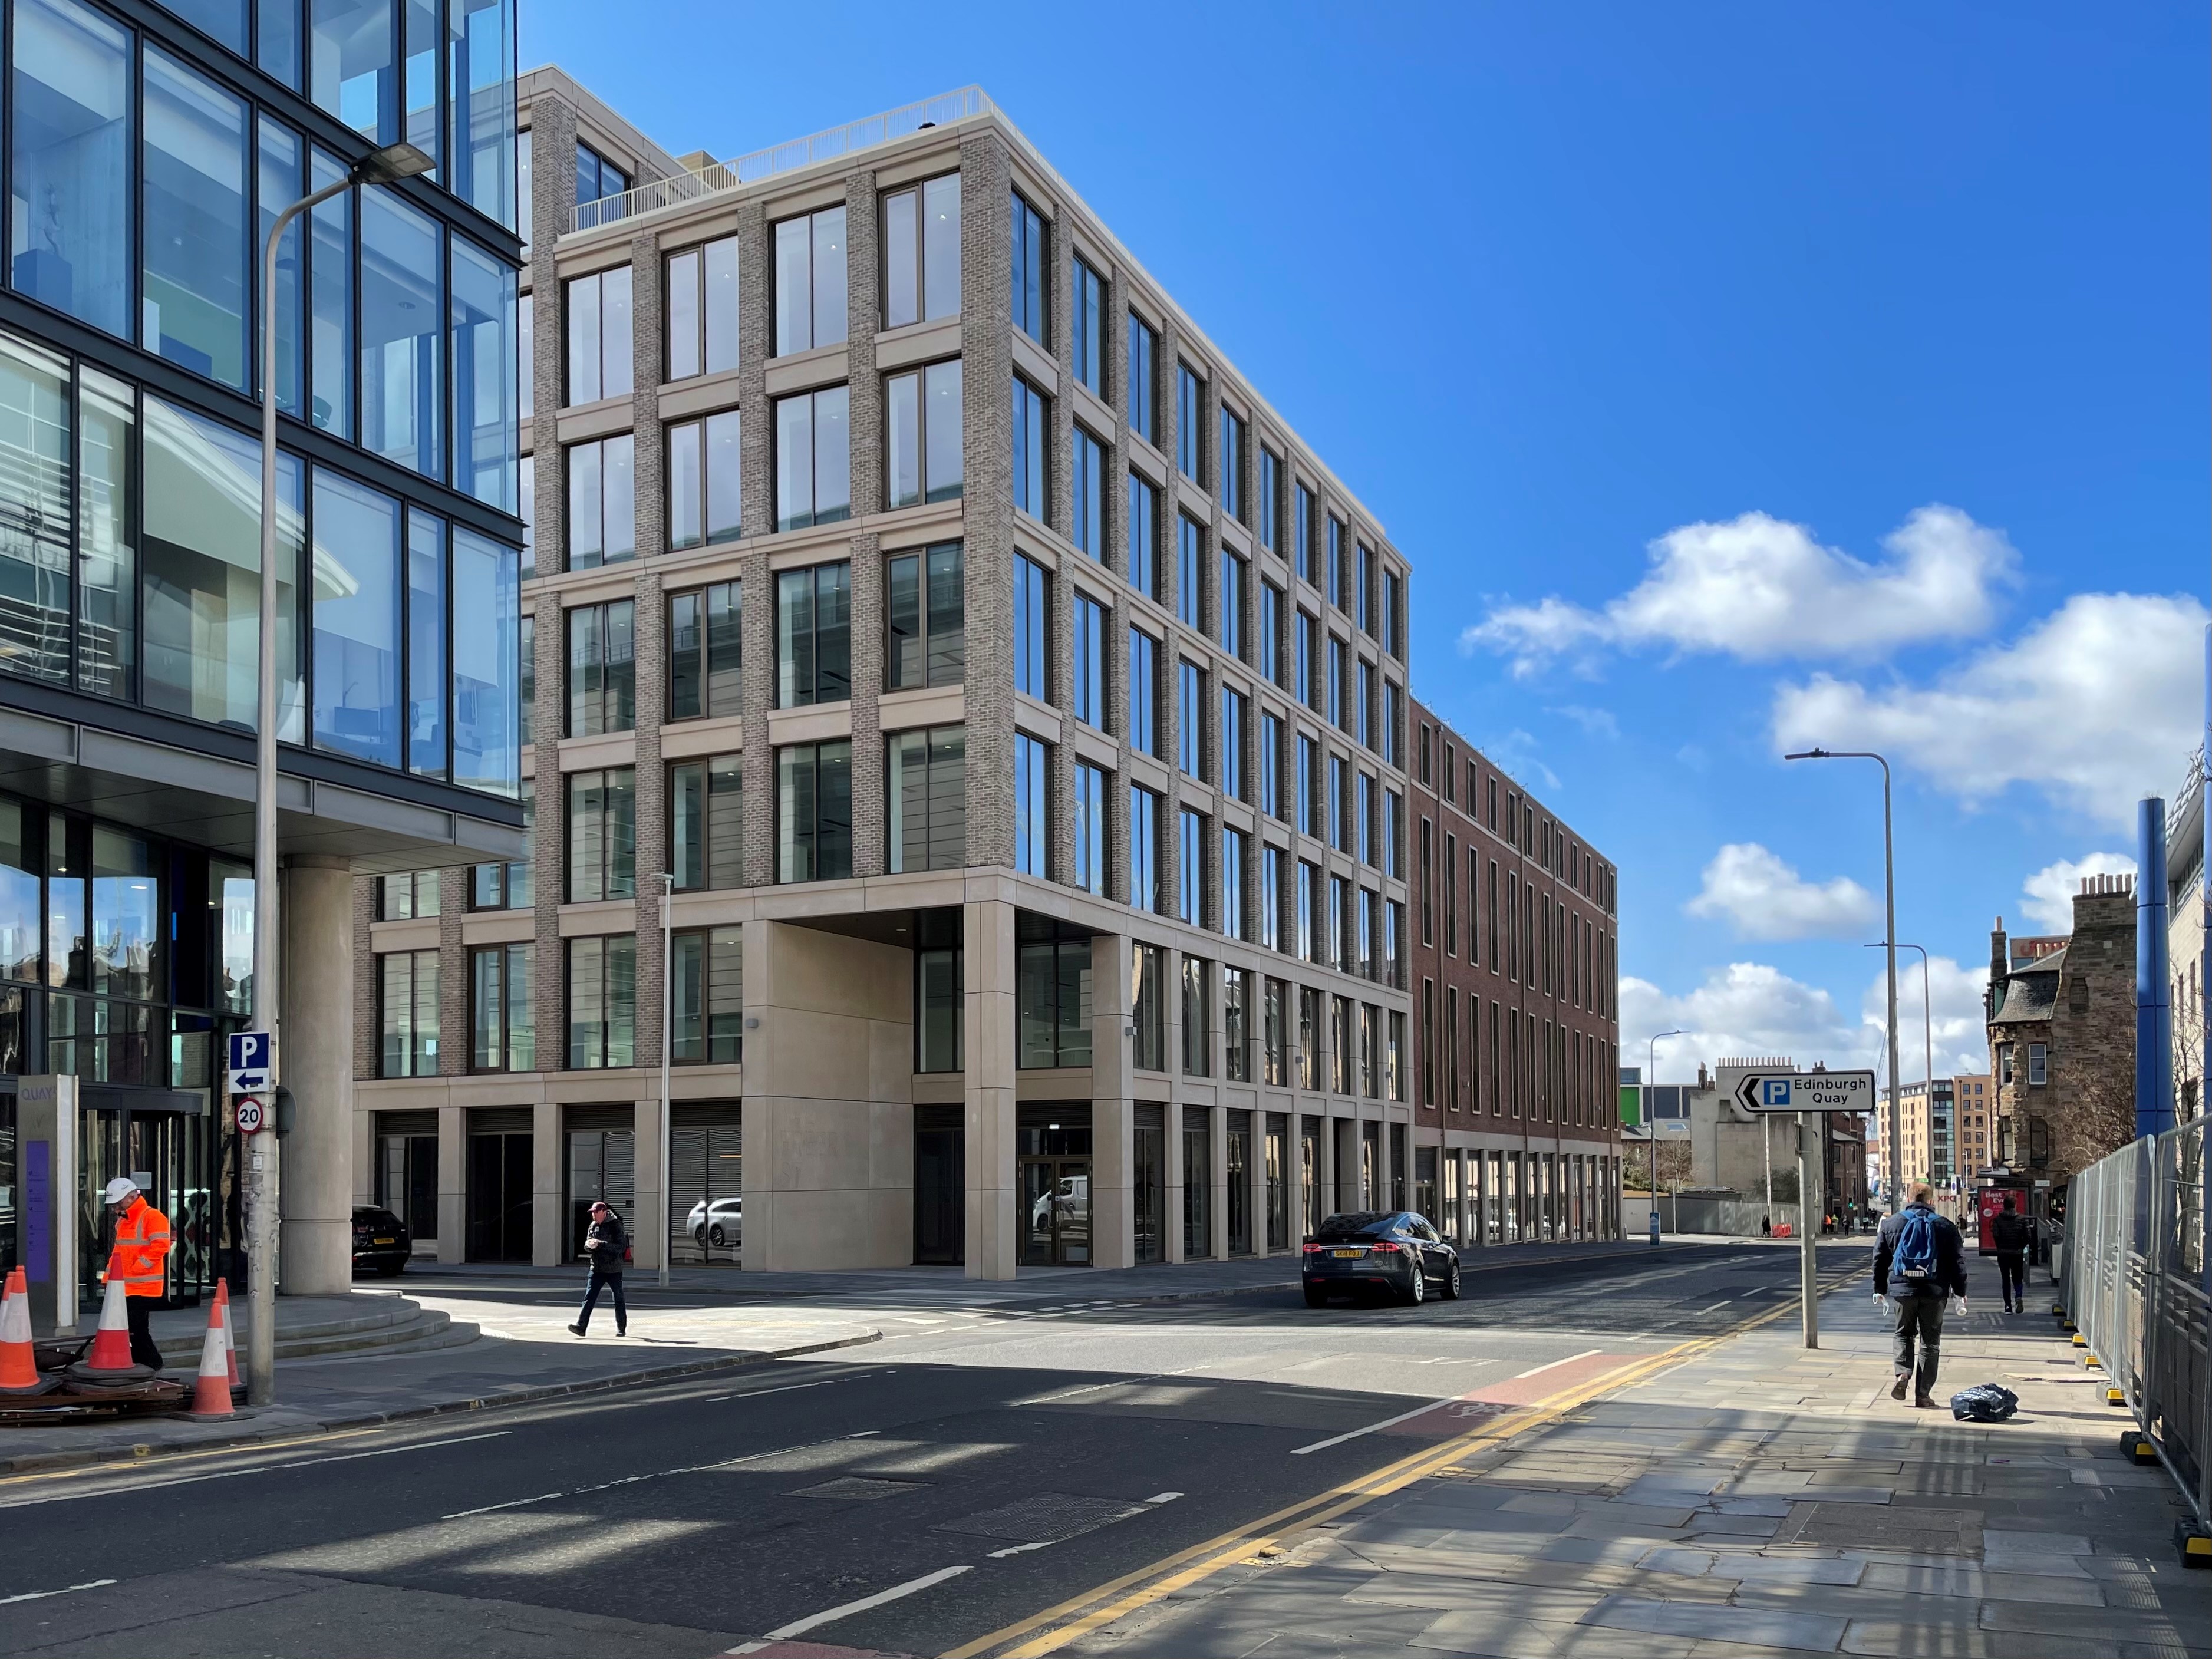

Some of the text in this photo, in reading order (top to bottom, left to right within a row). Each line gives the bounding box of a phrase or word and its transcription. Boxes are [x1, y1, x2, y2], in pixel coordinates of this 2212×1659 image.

[242, 1036, 258, 1067] P
[1770, 1078, 1866, 1103] P Edinburgh
[1812, 1093, 1848, 1104] Quay
[240, 1109, 258, 1123] 20
